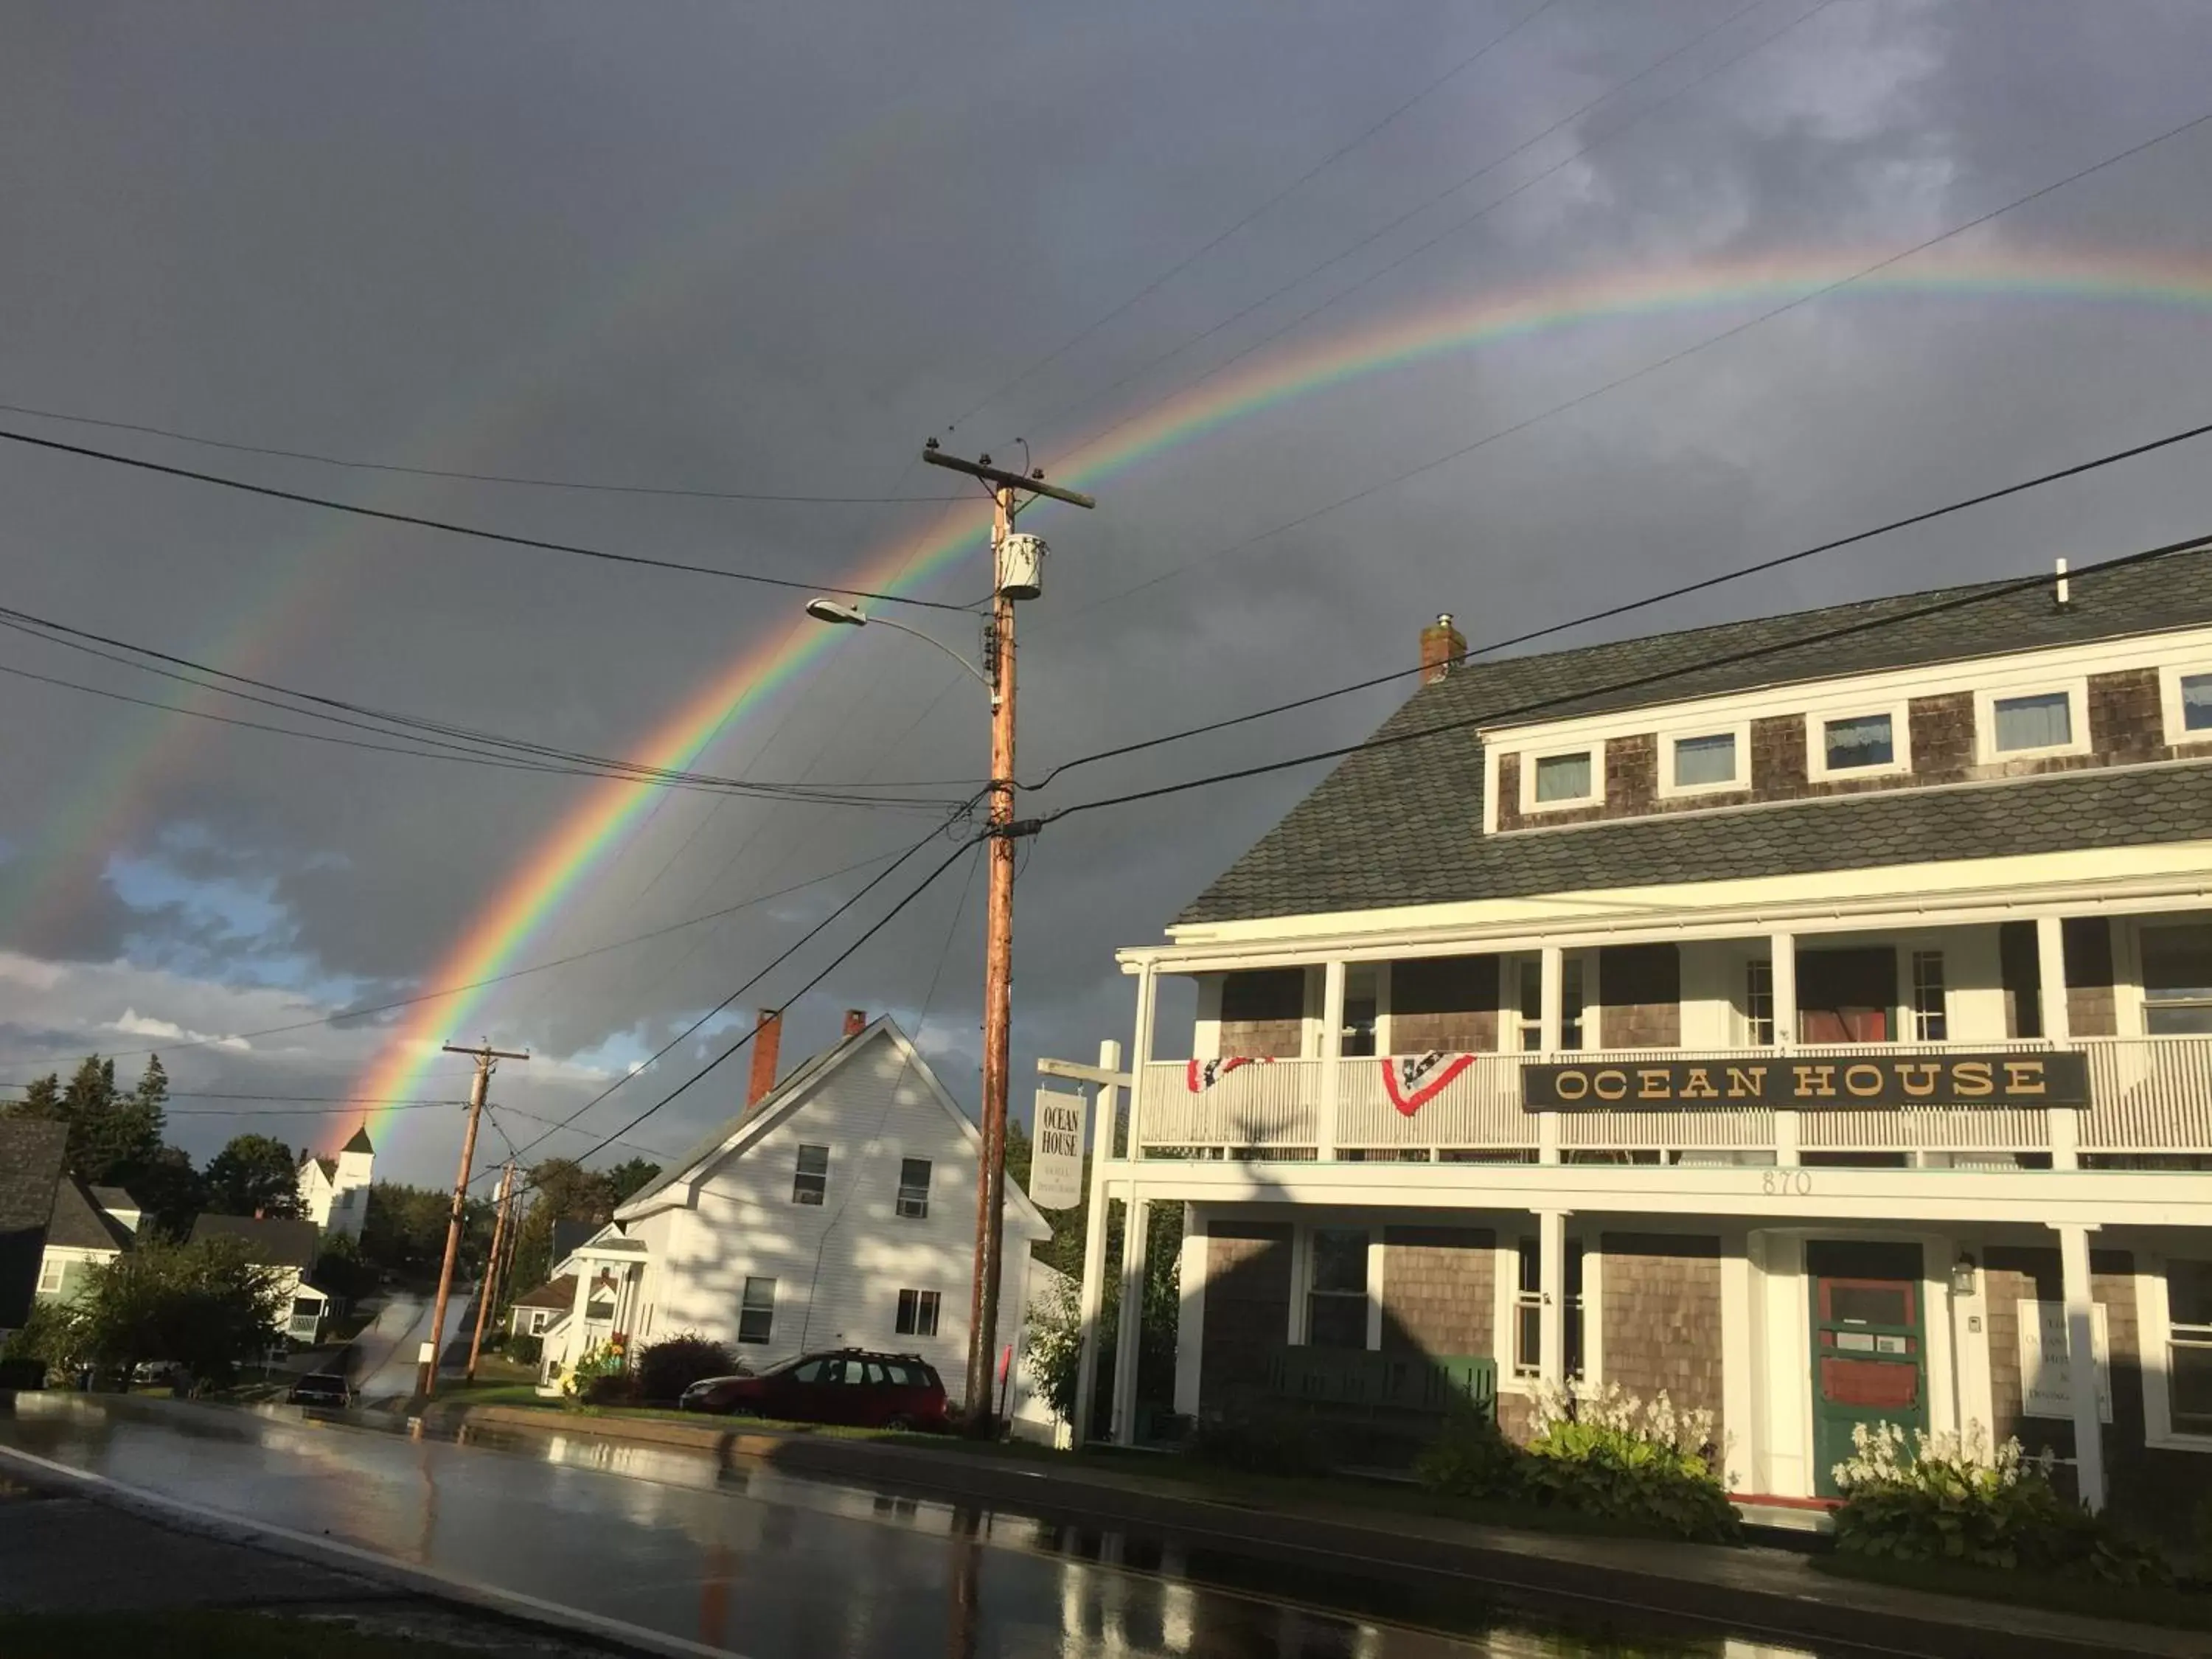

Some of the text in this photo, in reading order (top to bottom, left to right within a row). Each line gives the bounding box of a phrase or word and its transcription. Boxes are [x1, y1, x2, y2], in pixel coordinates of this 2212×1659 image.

[1555, 1062, 2046, 1099] OCEAN HOUSE
[1043, 1106, 1079, 1131] OCEAN
[1042, 1130, 1077, 1157] HOUSE
[1762, 1169, 1812, 1196] 870
